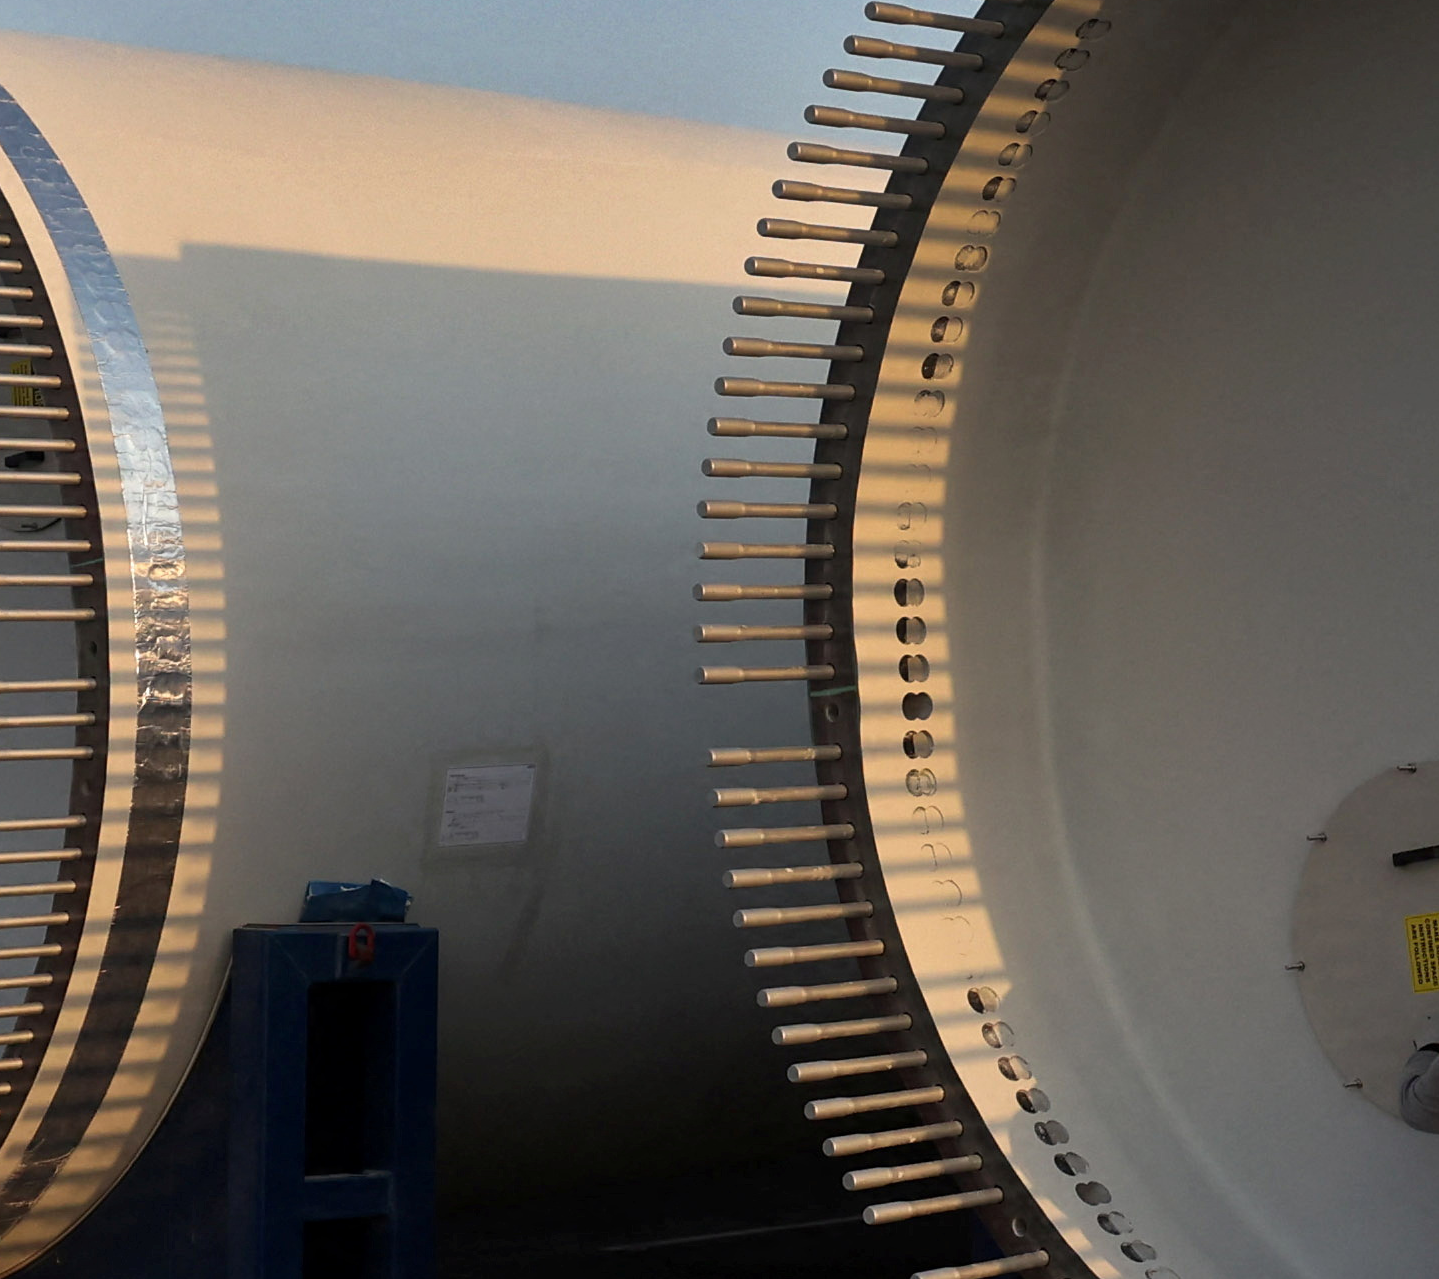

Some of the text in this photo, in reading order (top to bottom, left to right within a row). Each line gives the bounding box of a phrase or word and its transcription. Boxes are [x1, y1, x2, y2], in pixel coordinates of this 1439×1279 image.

[1418, 924, 1431, 983] INSTRUCTIONS
[1424, 918, 1439, 987] CONFINED SPACE
[1432, 919, 1439, 942] MAKE
[1413, 942, 1423, 985] FOLLOWED
